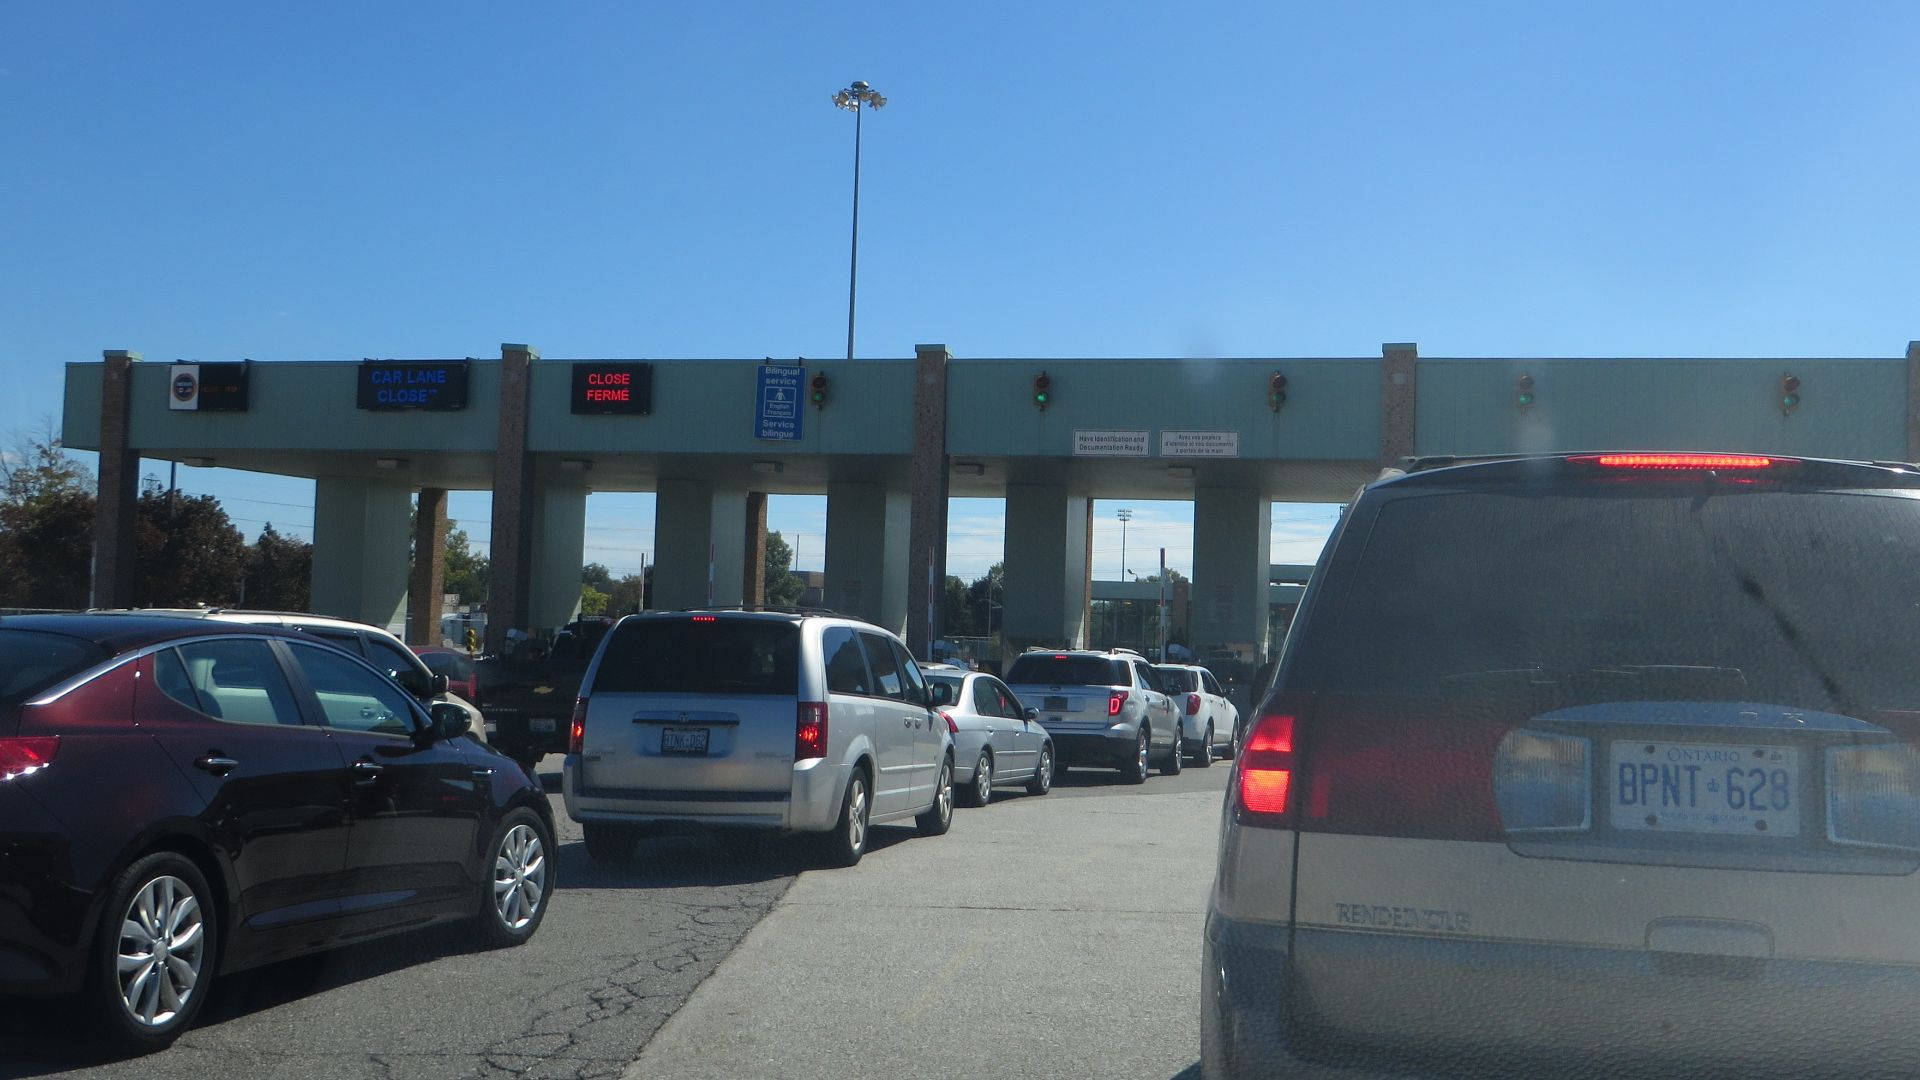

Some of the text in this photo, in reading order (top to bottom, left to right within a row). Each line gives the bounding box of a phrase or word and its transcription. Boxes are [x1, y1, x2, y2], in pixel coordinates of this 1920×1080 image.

[765, 367, 800, 376] Bilingual
[371, 370, 447, 384] CAR LANE
[588, 373, 630, 385] CLOSE
[766, 377, 797, 385] service
[762, 420, 795, 429] Service
[762, 429, 794, 438] bilingue
[1094, 435, 1133, 443] Identification
[1124, 444, 1144, 452] Ready
[1667, 747, 1740, 762] ONTARIO
[1618, 762, 1790, 811] BPNT 628
